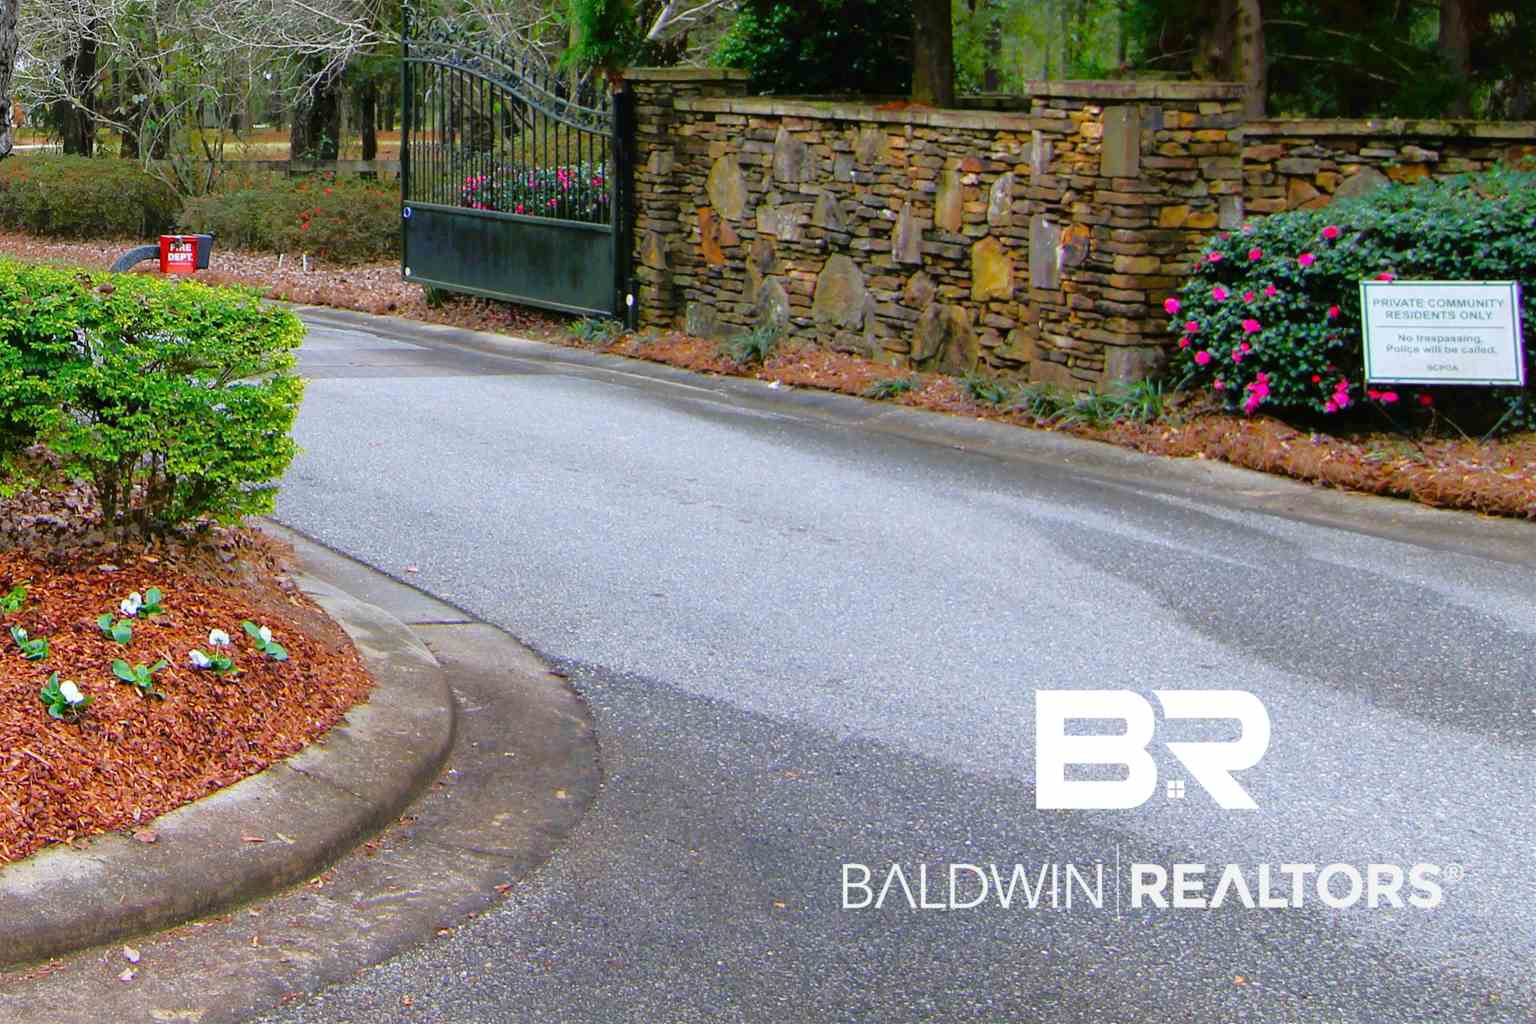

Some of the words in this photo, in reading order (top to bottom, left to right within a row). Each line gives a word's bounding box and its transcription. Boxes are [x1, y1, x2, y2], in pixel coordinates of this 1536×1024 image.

[1373, 298, 1424, 308] PRIVATE
[1427, 298, 1505, 308] COMMUNITY
[1385, 310, 1456, 320] RESIDENTS
[1459, 310, 1493, 320] ONLY
[1398, 334, 1415, 343] No
[1386, 344, 1421, 354] Police
[1423, 344, 1440, 354] will
[1443, 344, 1458, 354] be
[1461, 344, 1497, 354] called.
